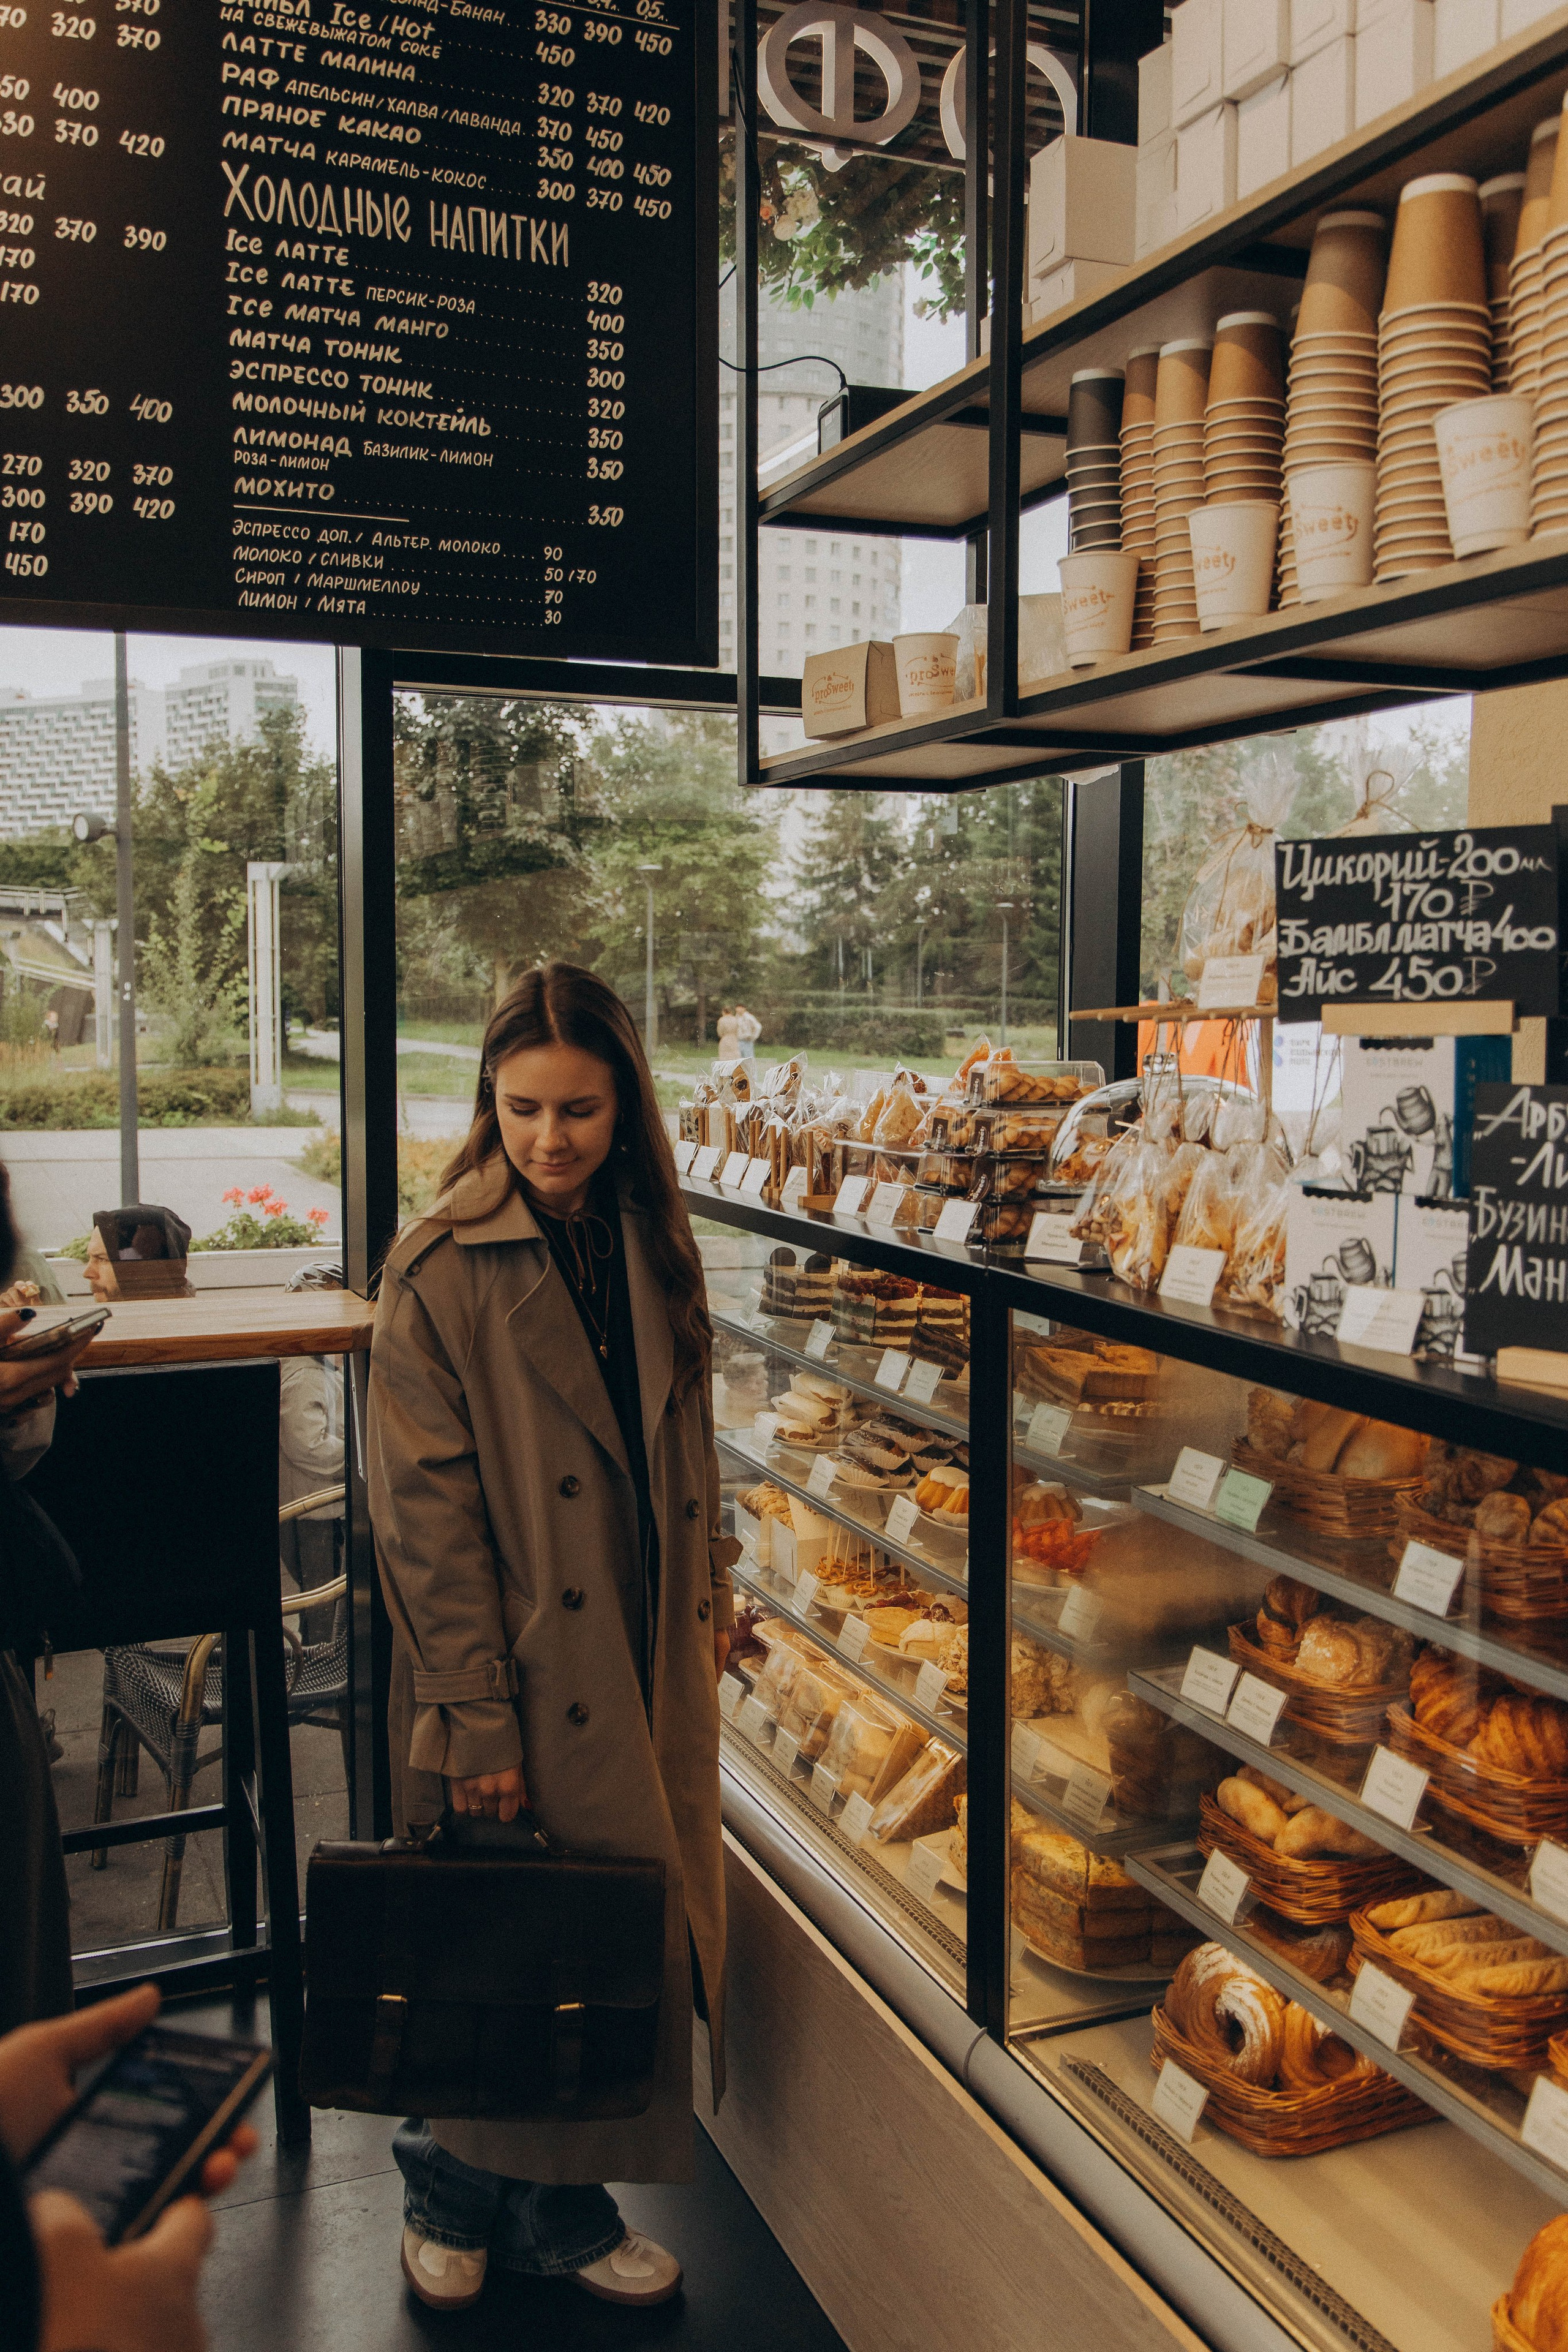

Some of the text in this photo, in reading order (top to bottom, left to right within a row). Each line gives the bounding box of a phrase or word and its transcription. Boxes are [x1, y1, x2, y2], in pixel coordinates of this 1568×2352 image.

[51, 12, 96, 40] 320
[118, 24, 160, 50] 370
[221, 7, 441, 58] НА СВЕЖЕВЫЖАТОМ СОКЕ
[330, 4, 371, 29] Ice
[537, 42, 575, 66] 450
[535, 10, 571, 34] 330
[584, 21, 622, 44] 390
[636, 31, 671, 55] 450
[53, 83, 99, 110] 400
[222, 32, 670, 125] ЛАТТЕ МАЛИНА 320 370 420
[222, 62, 279, 89] РАФ
[538, 117, 571, 141] 370
[586, 127, 623, 151] 450
[55, 119, 98, 146] 370
[119, 130, 164, 157] 420
[222, 96, 671, 186] ПРЯНОЕ КАКАО 350 400 450
[223, 132, 315, 160] МАТЧА
[537, 179, 575, 201] 300
[587, 188, 622, 211] 370
[635, 196, 671, 219] 450
[55, 217, 96, 243] 370
[125, 226, 166, 251] 390
[431, 201, 568, 267] НАПИТКИ
[225, 229, 622, 304] Ice ЛАТТЕ 320
[1, 282, 39, 304] 170
[225, 262, 268, 284] Ice
[282, 273, 355, 296] ЛАТТЕ
[587, 310, 624, 333] 400
[227, 295, 624, 360] Ice МАТЧА МАНГО 350
[230, 329, 625, 390] МАТЧА ТОНИК 300
[0, 385, 172, 422] 300 350 400
[230, 360, 625, 419] ЭСПРЕССО ТОНИК 320
[233, 392, 623, 450] МОЛОЧНЫЙ КОКТЕЙЛЬ 350
[2, 454, 173, 485] 270 320 370
[233, 427, 352, 458] ЛИМОНАД
[587, 458, 624, 480] 350
[2, 486, 175, 518] 300 390 420
[235, 477, 624, 527] МОХИТО 350
[10, 522, 45, 543] 170
[233, 519, 310, 540] ЭСПРЕССО
[439, 540, 500, 554] МОЛОКО
[545, 547, 562, 560] 90
[6, 553, 48, 576] 450
[233, 546, 301, 564] МОЛОКО
[321, 552, 383, 568] СЛИВКИ
[236, 568, 284, 585] СИРОП
[307, 573, 420, 595] МАРШМЕЛЛОУ
[545, 590, 563, 603] 70
[239, 590, 297, 609] ЛИМОН
[318, 596, 365, 614] МЯТА
[545, 610, 561, 624] 30
[1282, 957, 1358, 998] Айс
